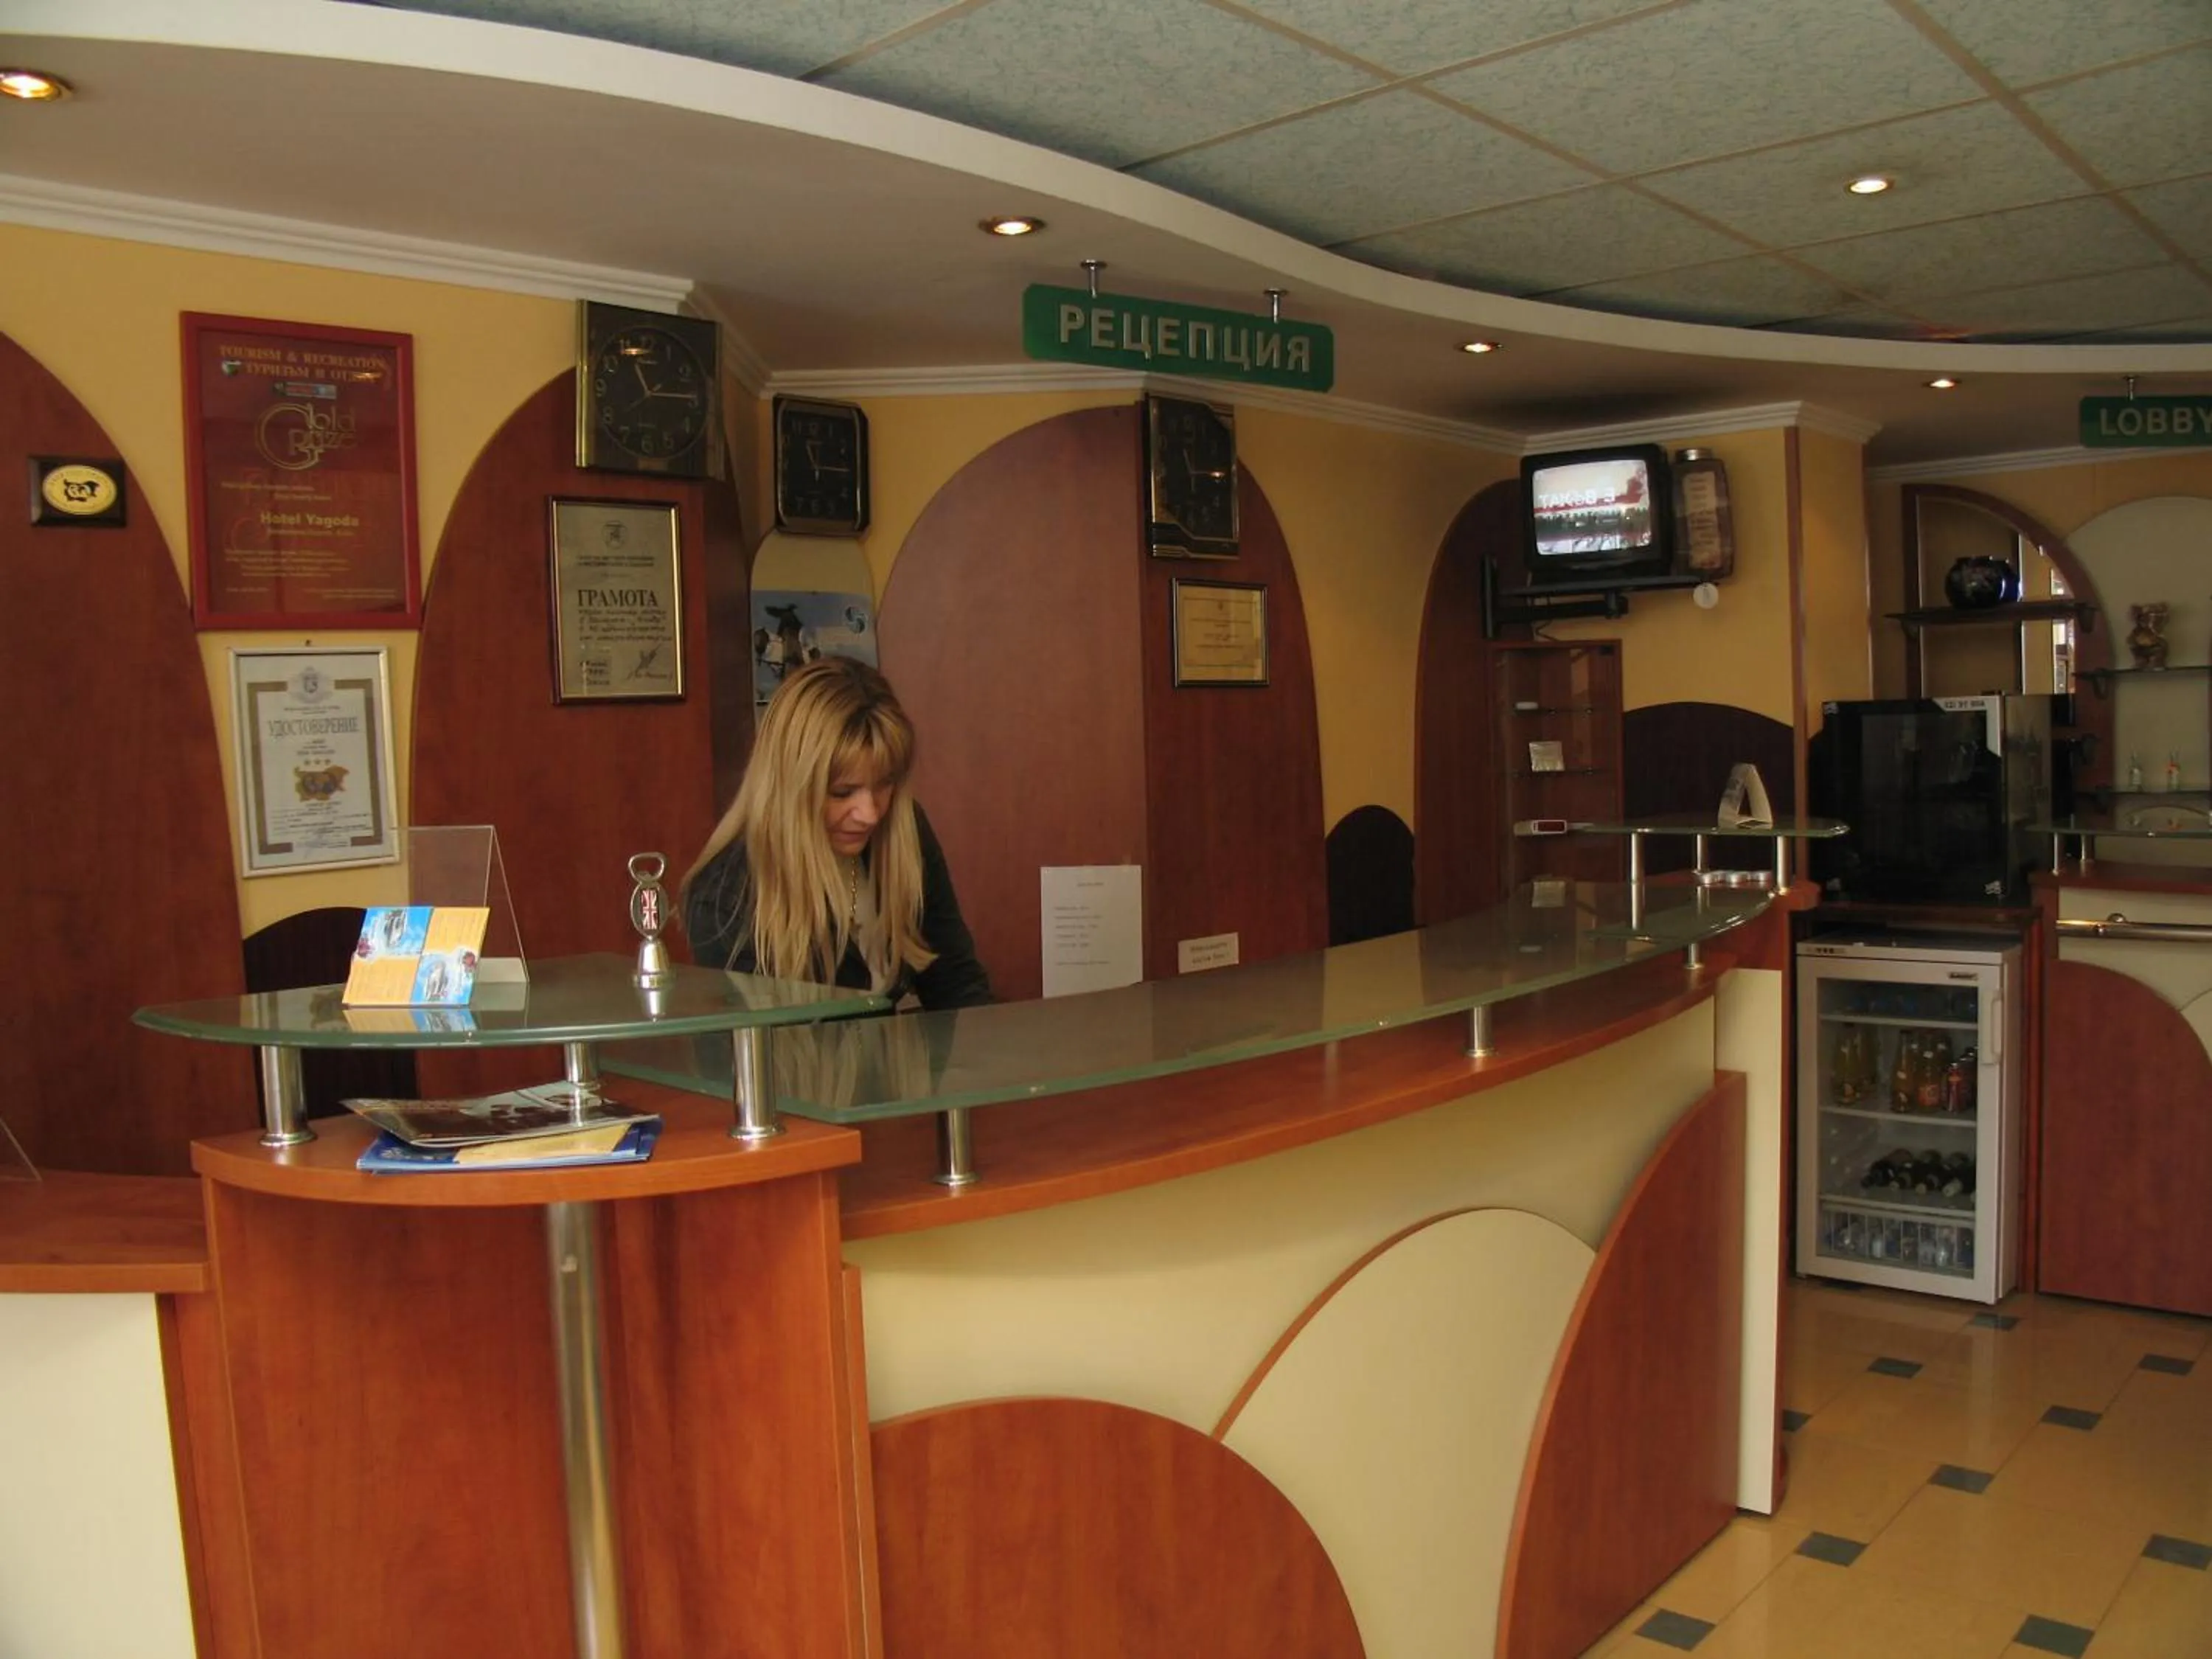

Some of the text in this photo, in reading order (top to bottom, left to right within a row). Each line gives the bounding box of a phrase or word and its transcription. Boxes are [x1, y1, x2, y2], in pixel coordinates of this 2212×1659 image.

[1060, 303, 1311, 372] РЕЦЕПЦИЯ
[219, 344, 282, 361] TOURISM
[2100, 407, 2212, 436] LOBBY
[260, 511, 360, 529] Hotel Yagoda
[577, 589, 660, 607] ГРАМОТА
